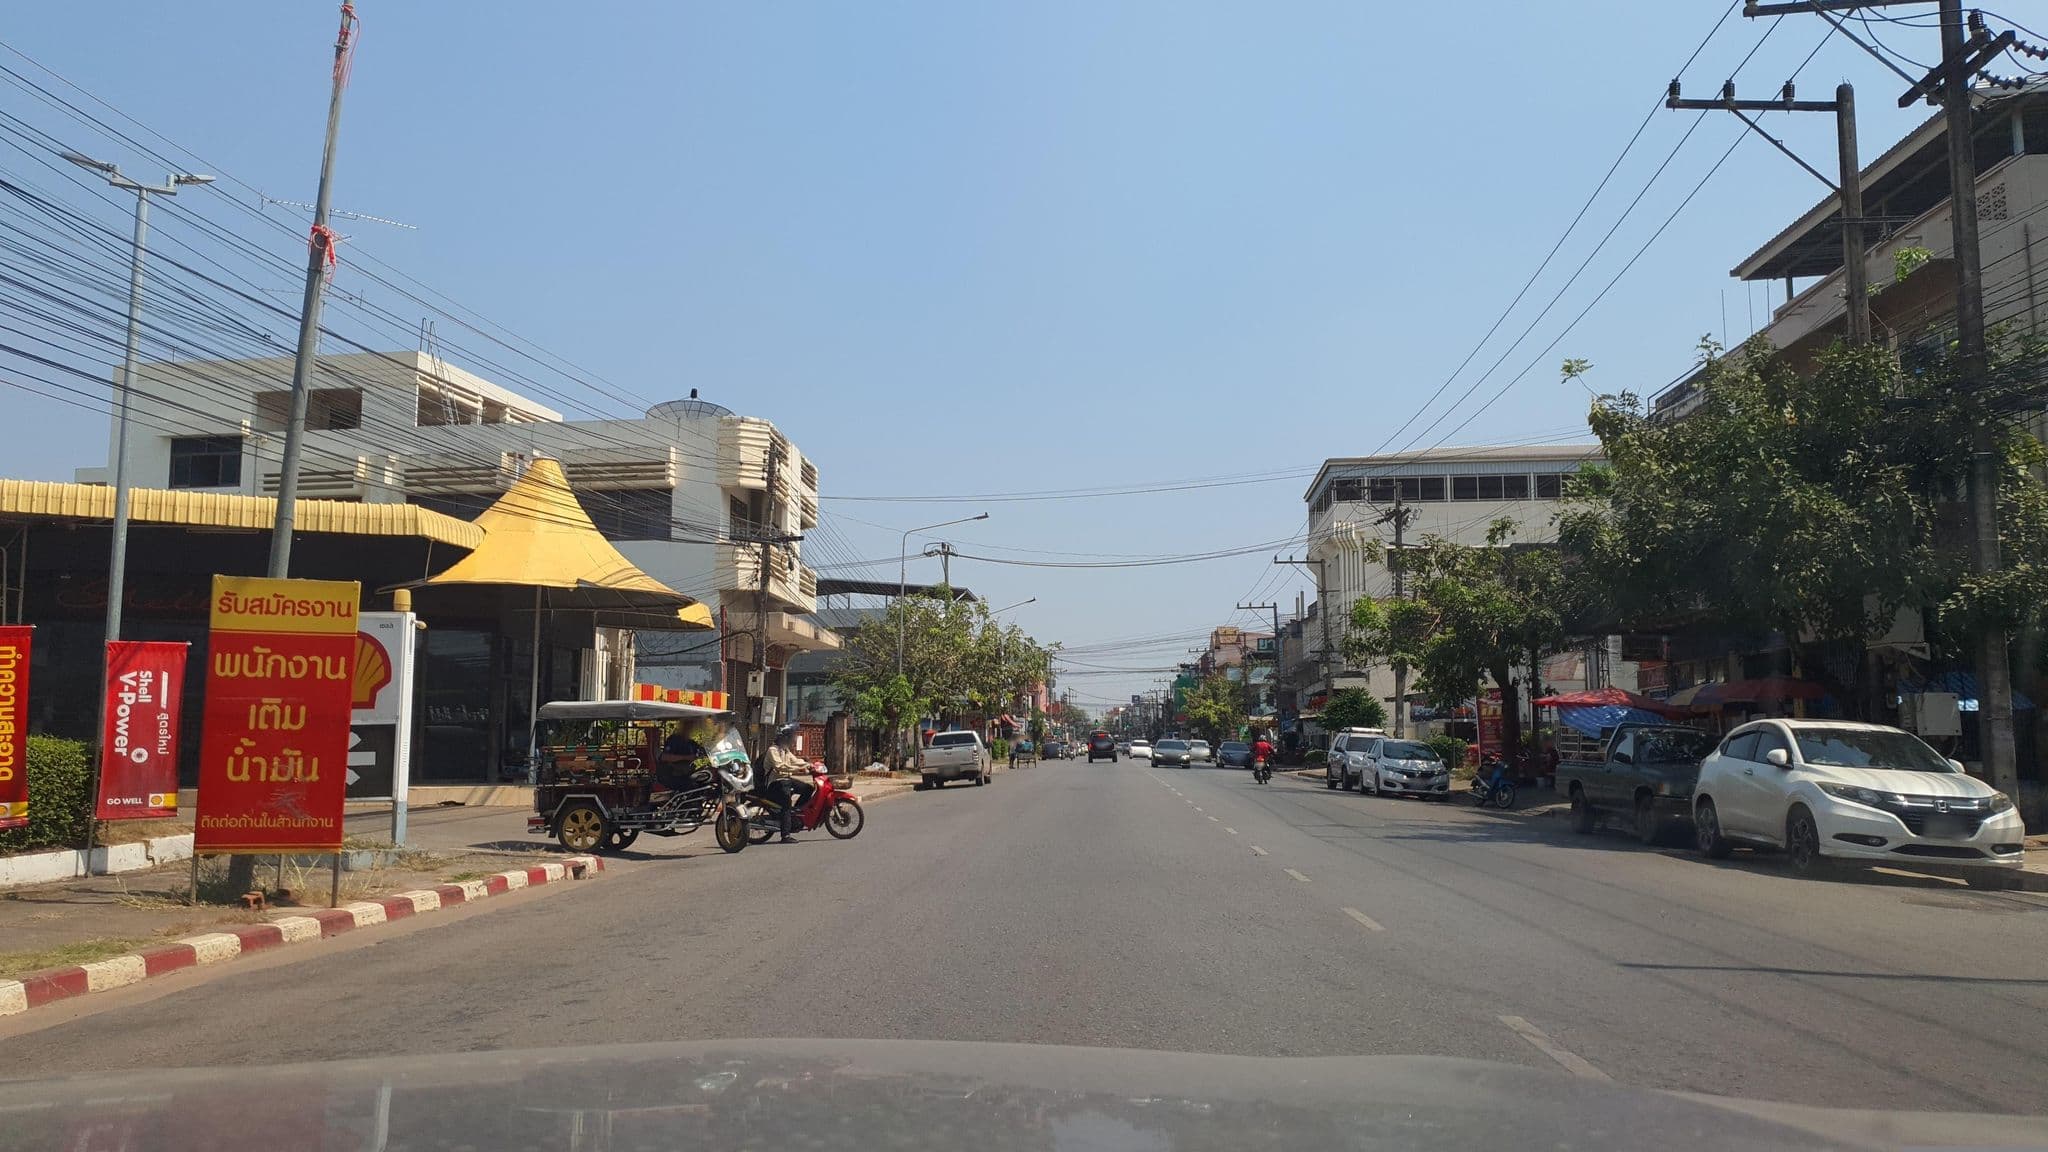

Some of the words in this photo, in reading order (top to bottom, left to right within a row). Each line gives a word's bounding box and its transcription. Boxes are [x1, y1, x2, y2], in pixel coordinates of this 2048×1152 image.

[218, 591, 353, 618] รับสมัครงาน
[215, 646, 347, 680] พนักงาน
[138, 670, 153, 703] Shell
[114, 671, 138, 757] V-Power
[248, 697, 307, 730] เติม
[226, 737, 320, 782] น้ำมัน
[122, 797, 143, 805] WELL
